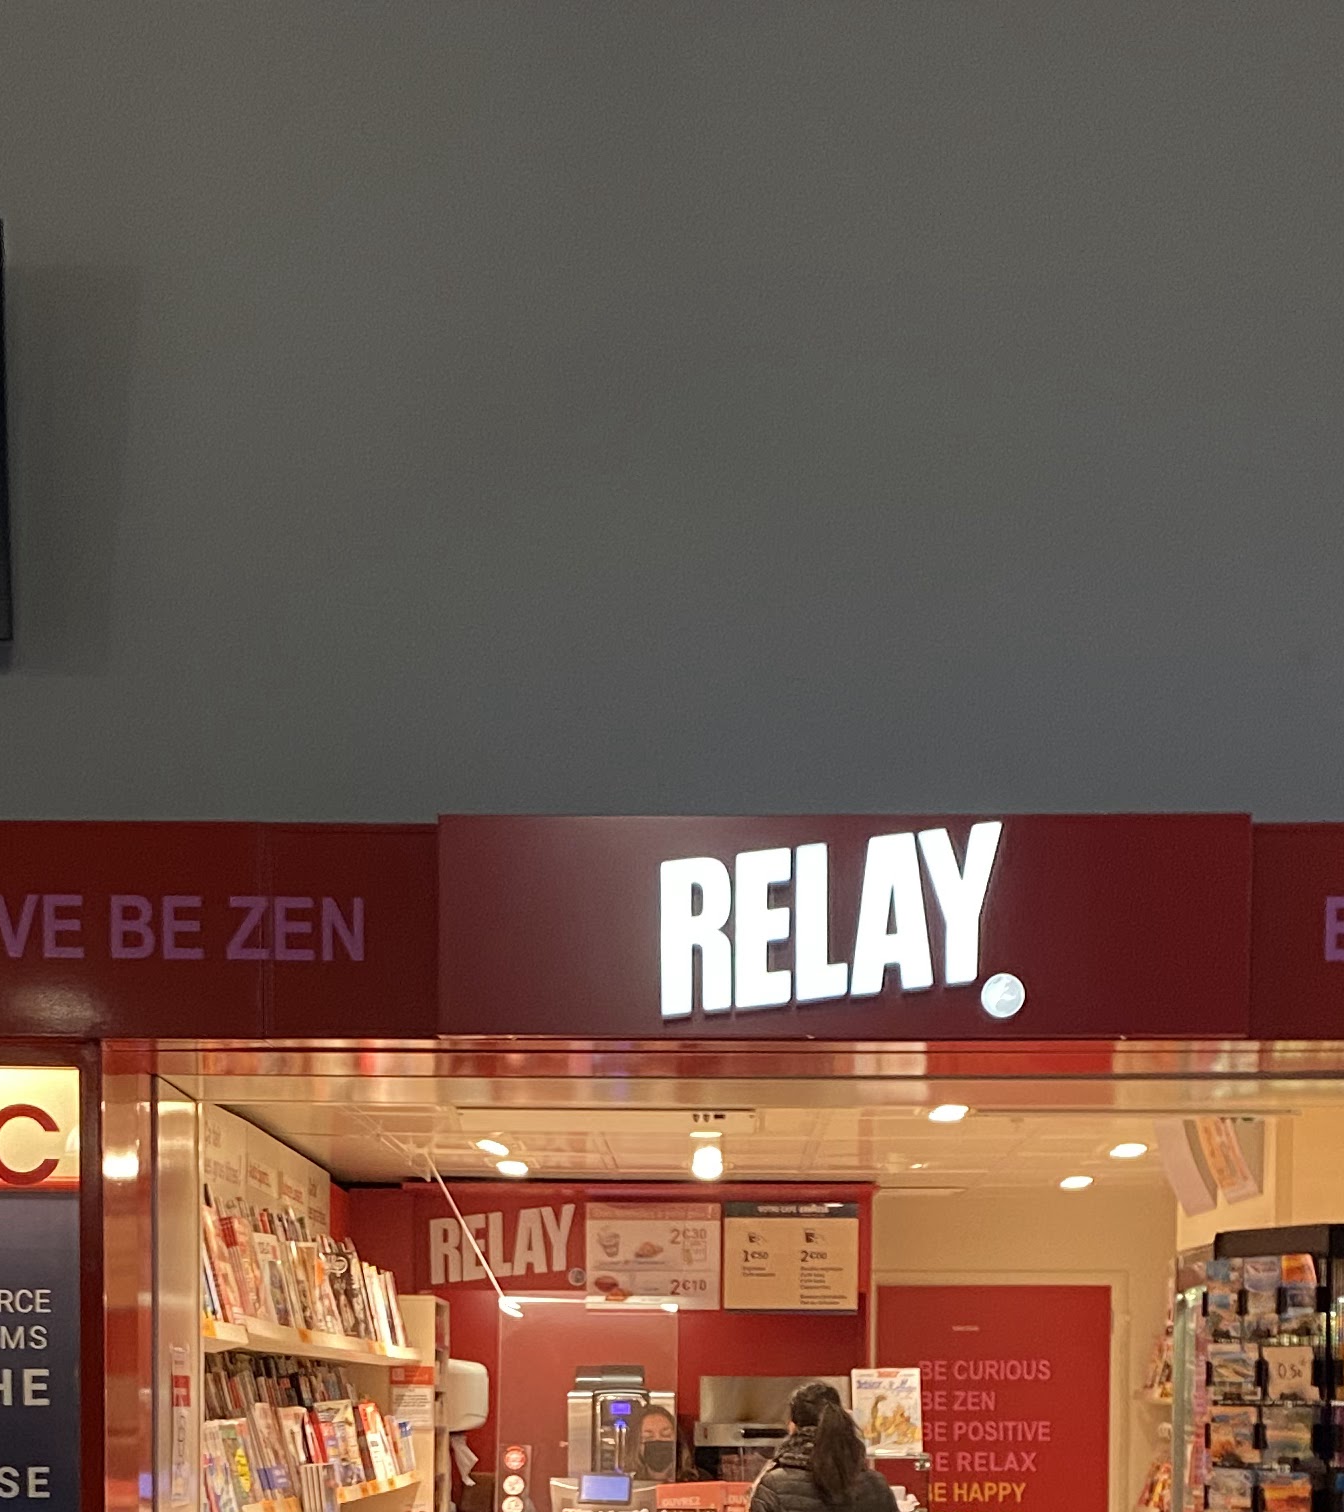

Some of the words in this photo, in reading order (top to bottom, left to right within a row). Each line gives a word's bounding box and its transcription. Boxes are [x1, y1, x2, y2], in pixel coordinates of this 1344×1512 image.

[109, 893, 203, 960] BE
[225, 896, 365, 962] ZEN
[659, 821, 1003, 1021] RELAY
[429, 1203, 576, 1285] RELAY
[918, 1360, 948, 1380] BE
[953, 1360, 1051, 1380] CURIOUS
[921, 1391, 948, 1411] BE
[952, 1391, 996, 1411] ZEN
[922, 1421, 948, 1441] BE
[952, 1421, 1051, 1442] POSITIVE
[930, 1452, 949, 1472] E
[955, 1452, 1037, 1472] RELAX
[952, 1482, 1026, 1502] HAPPY
